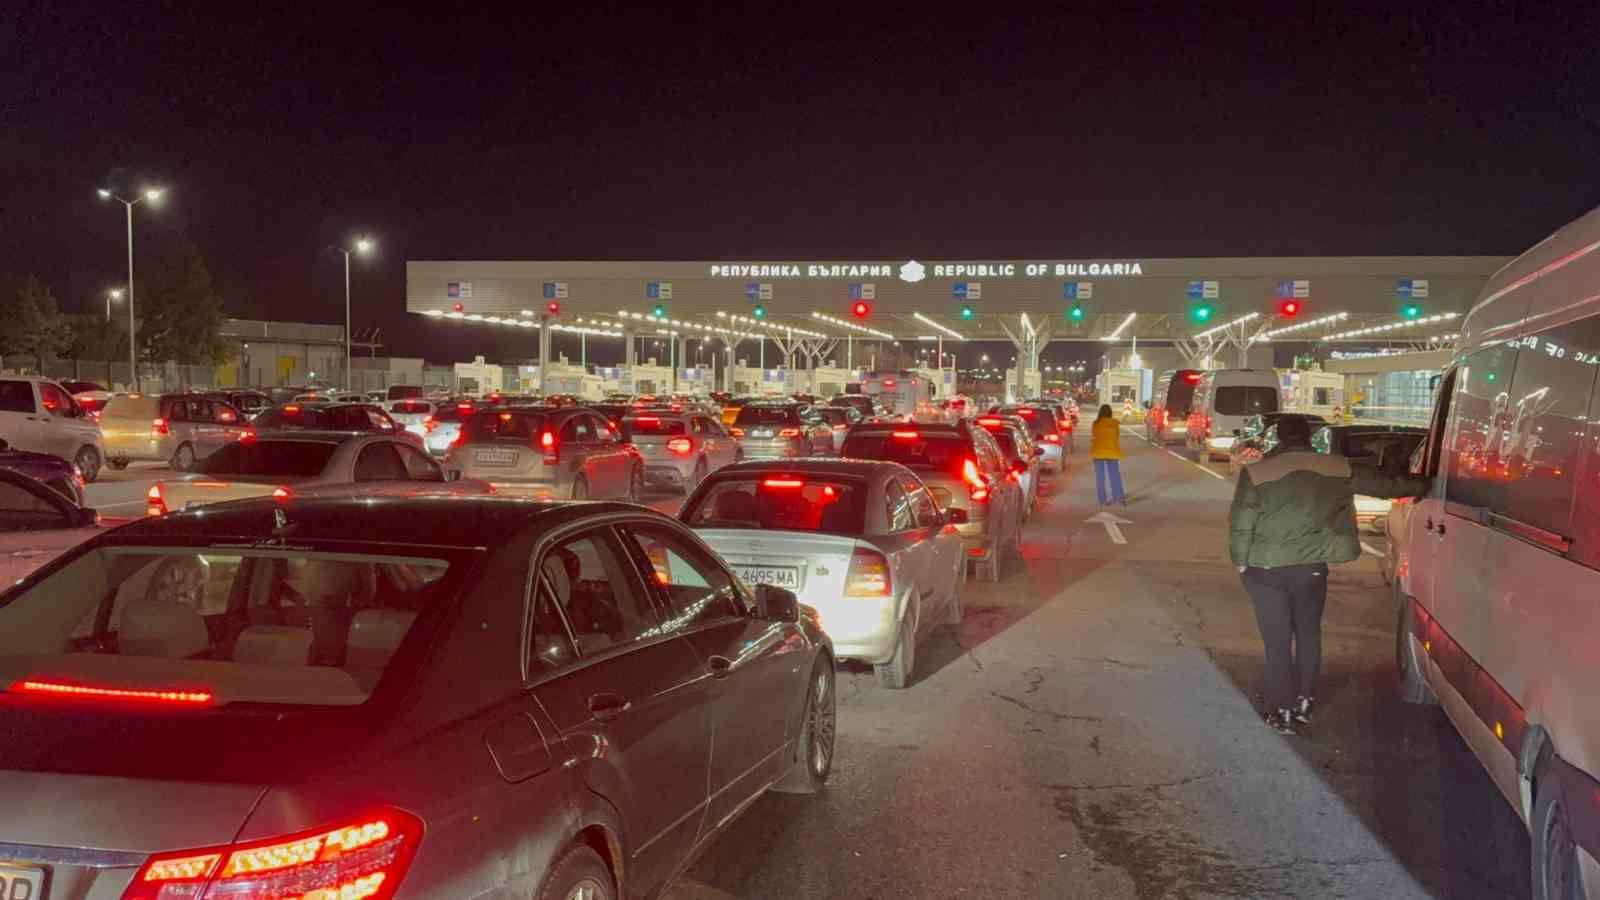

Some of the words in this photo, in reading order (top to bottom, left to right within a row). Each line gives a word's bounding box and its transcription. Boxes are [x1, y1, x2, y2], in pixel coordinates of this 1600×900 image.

[710, 265, 801, 277] РЕПУБЛИКА
[808, 265, 891, 278] БЪЛГАРИЯ
[934, 264, 1015, 277] REPUBLIC
[1025, 264, 1048, 276] OF
[1055, 263, 1143, 276] BULGARIA
